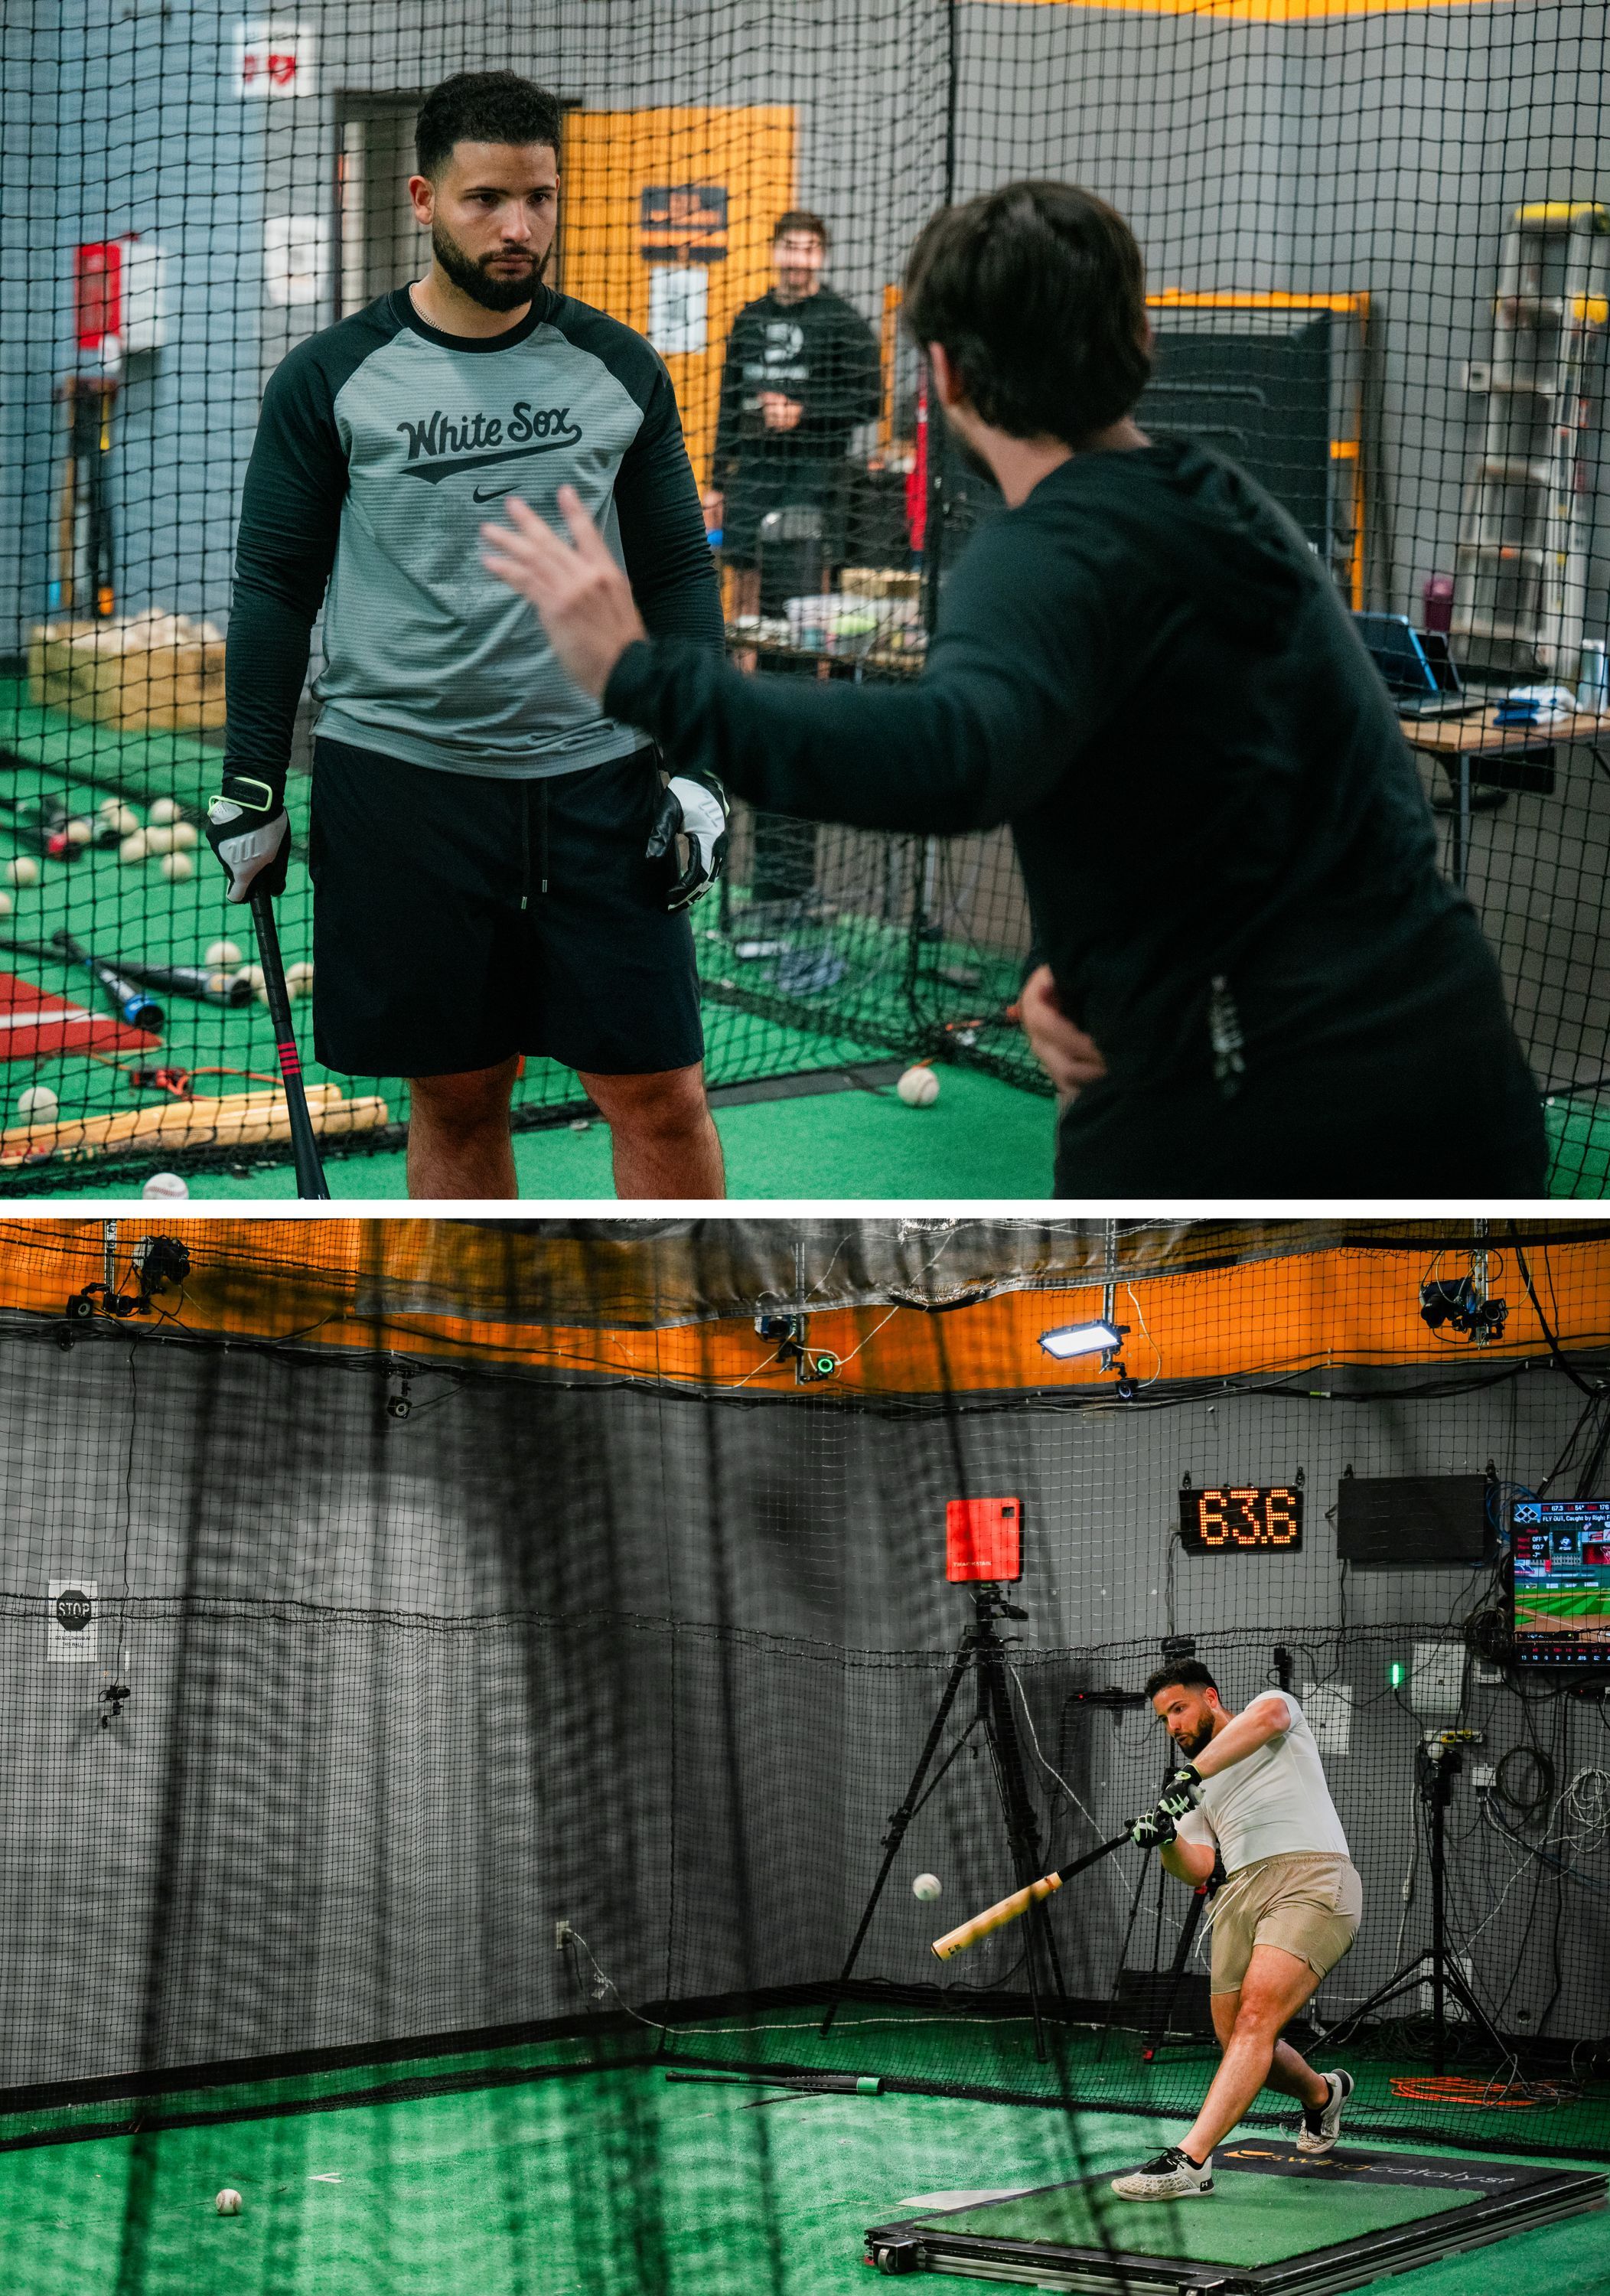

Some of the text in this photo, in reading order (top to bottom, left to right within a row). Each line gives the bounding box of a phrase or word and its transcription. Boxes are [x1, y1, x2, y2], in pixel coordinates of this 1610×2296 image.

[396, 402, 574, 460] White Sox
[1199, 1489, 1297, 1544] 63.6
[59, 1602, 90, 1619] STOP
